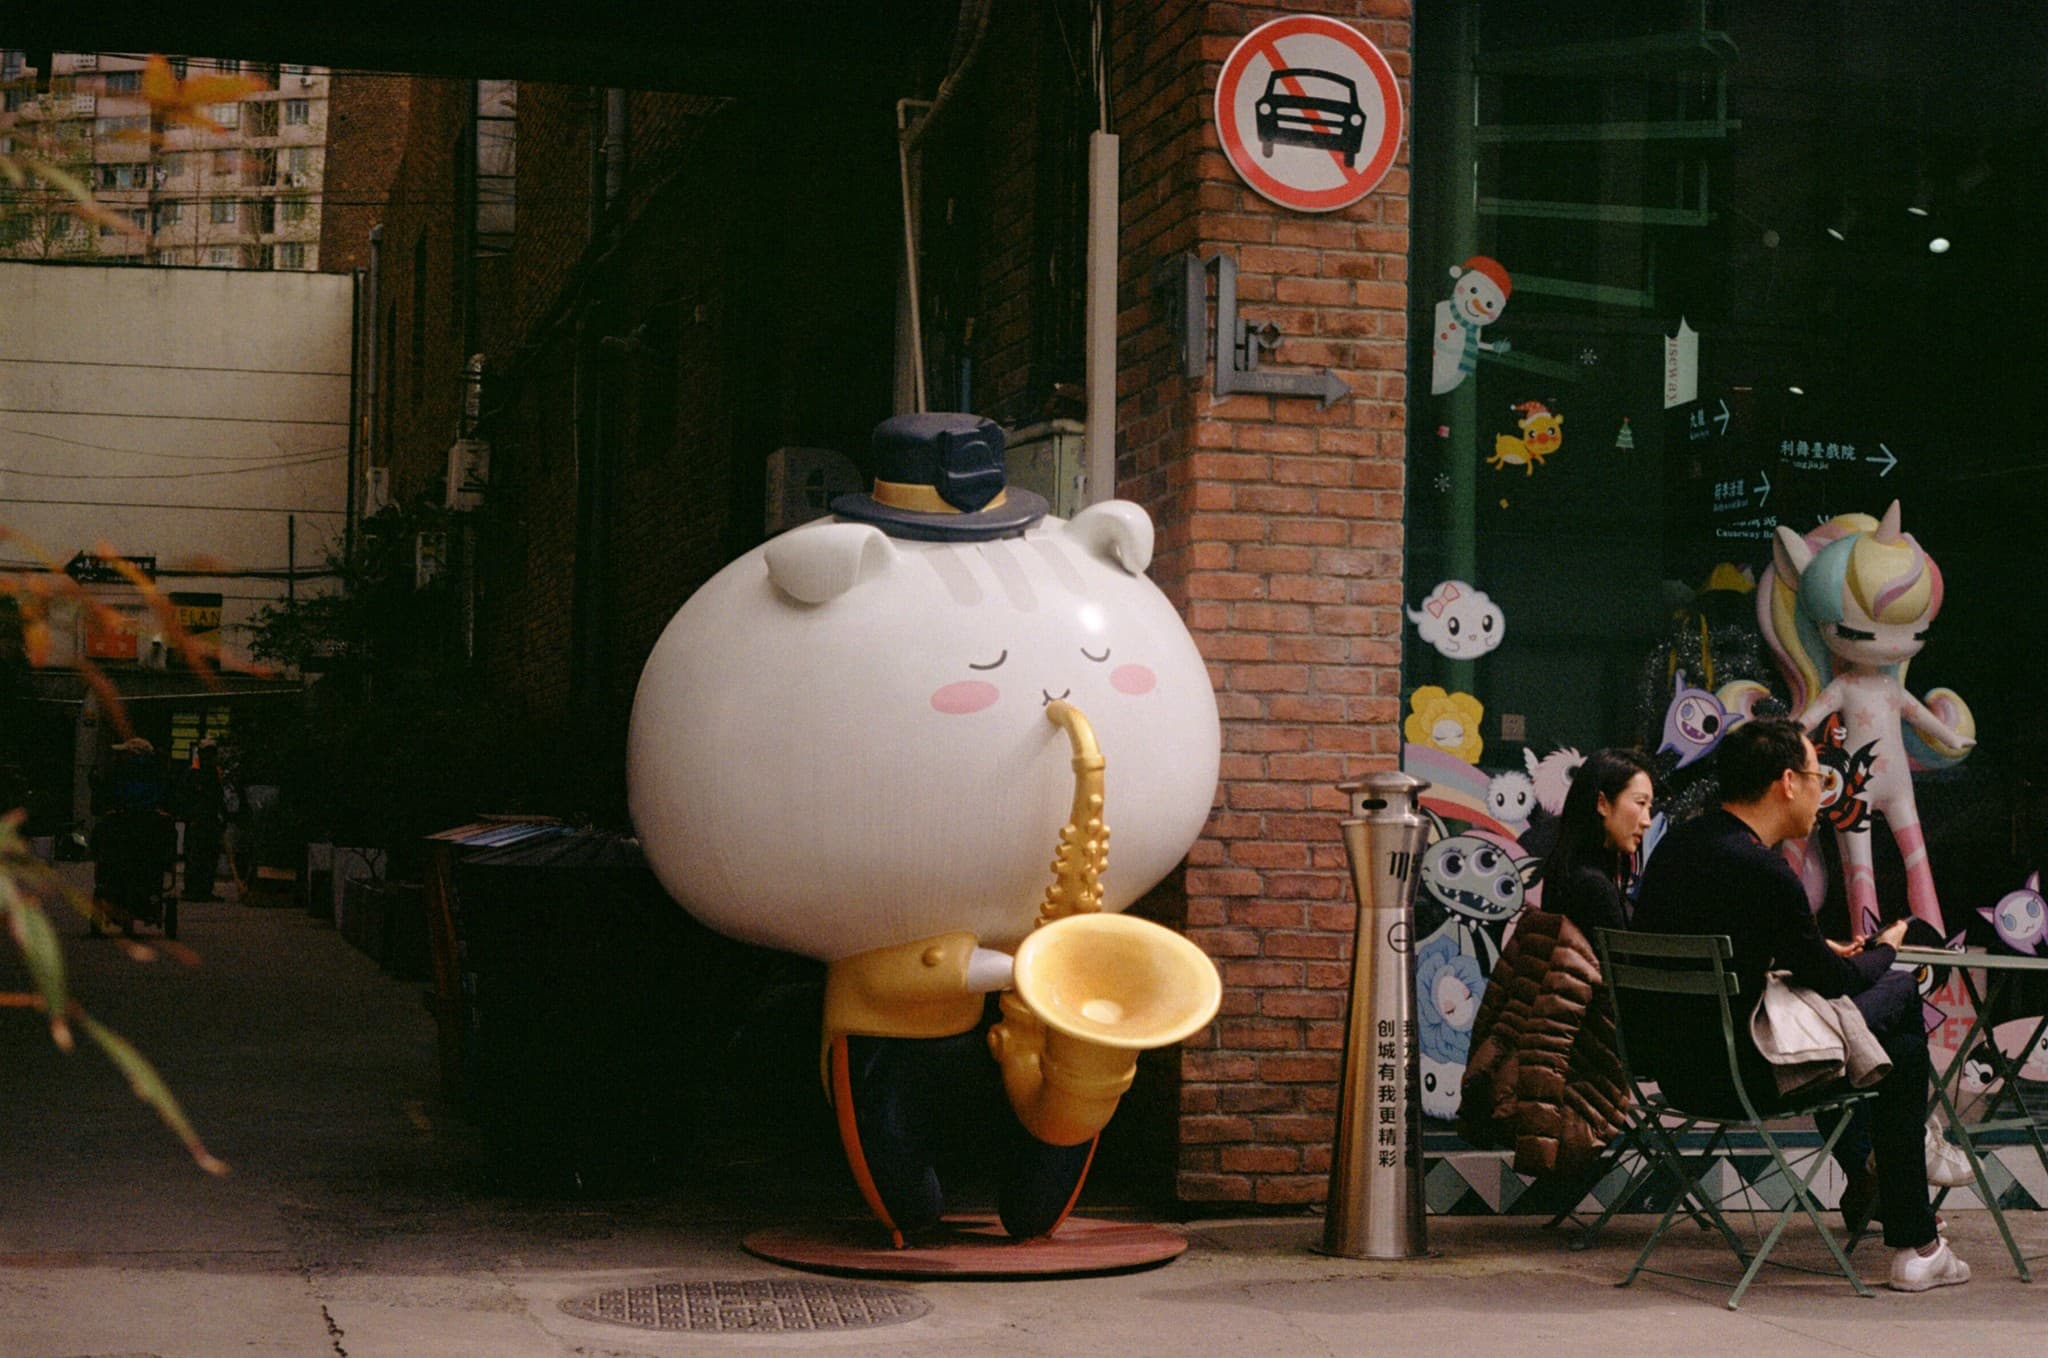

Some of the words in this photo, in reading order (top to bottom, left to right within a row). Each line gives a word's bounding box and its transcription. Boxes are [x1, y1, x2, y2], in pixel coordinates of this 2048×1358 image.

[1377, 1020, 1396, 1168] 创城有我更精彩
